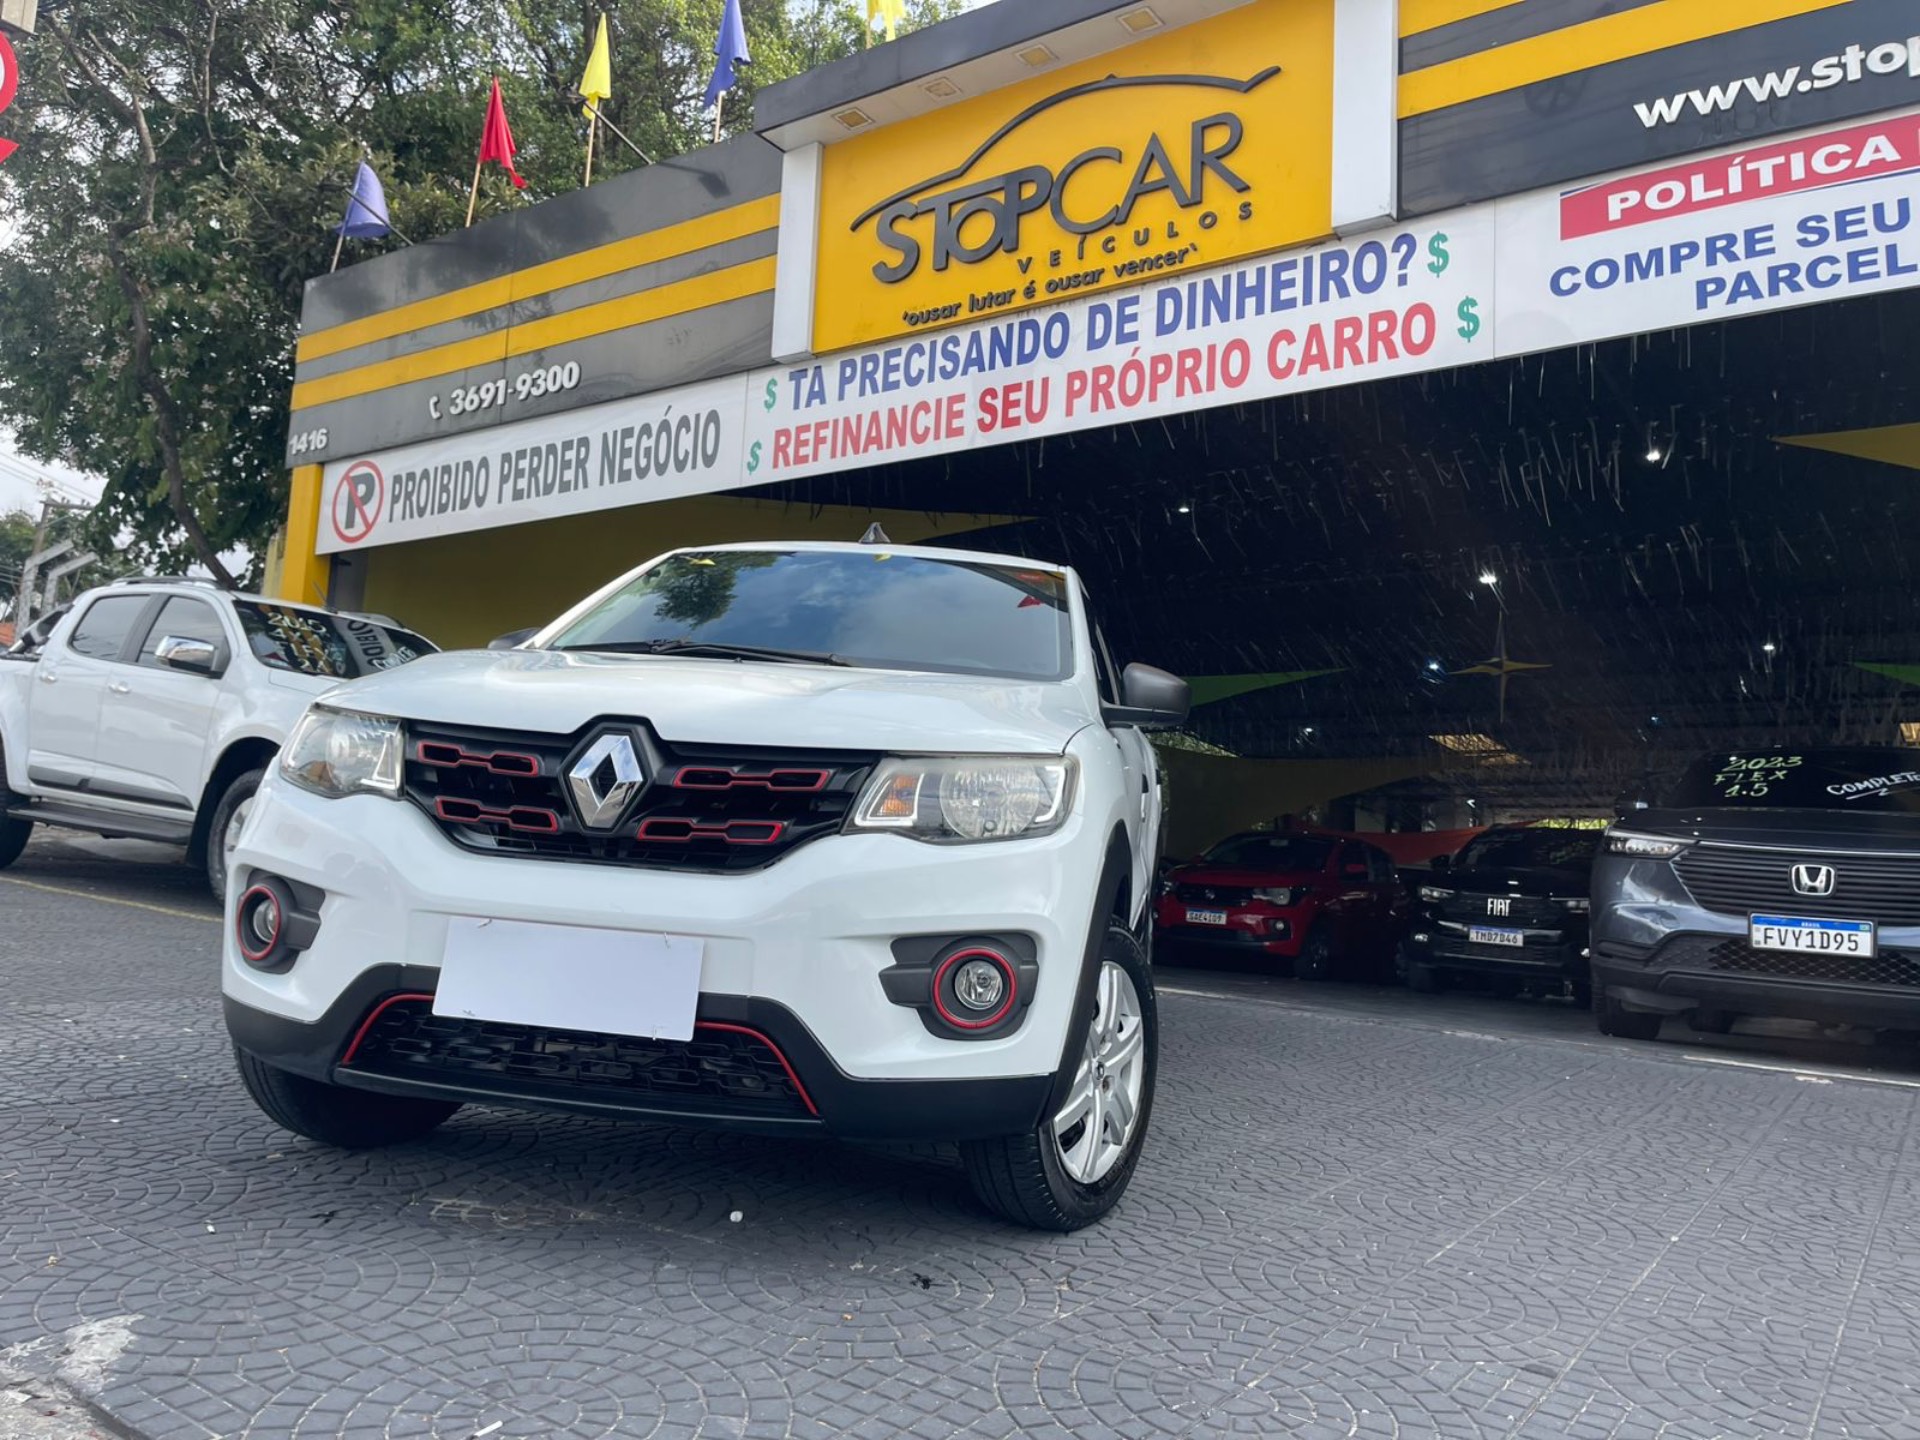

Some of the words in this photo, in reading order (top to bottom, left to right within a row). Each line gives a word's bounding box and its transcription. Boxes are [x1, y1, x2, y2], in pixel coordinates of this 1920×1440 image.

[871, 112, 1251, 284] STOPCAR
[1607, 135, 1901, 222] POLÍTICA
[1017, 201, 1253, 274] VEÍCULOS
[1549, 222, 1776, 297] COMPRE
[1796, 197, 1911, 248] SEU
[968, 285, 1016, 312] lutar
[1023, 280, 1036, 298] é
[1045, 266, 1105, 293] ousar
[1696, 243, 1918, 311] PARCEL
[789, 364, 827, 410] TA
[838, 312, 1071, 401] PRECISANDO
[1086, 294, 1141, 352] DE
[1155, 232, 1417, 338] DINHEIRO?
[450, 361, 582, 416] 3691-9300
[772, 393, 966, 469] REFINANCIE
[977, 374, 1050, 433] SEU
[1065, 337, 1250, 417] PRÓPRIO
[1267, 302, 1436, 380] CARRO
[289, 427, 328, 455] 1416
[388, 455, 490, 524] PROIBIDO
[497, 436, 591, 505] PERDER
[599, 405, 721, 486] NEGÓCIO
[1713, 770, 1788, 785] FLEX
[1722, 756, 1803, 772] 2023
[1724, 783, 1769, 798] 1.5
[1487, 898, 1511, 917] FIAT
[1763, 927, 1859, 952] FVY1D95
